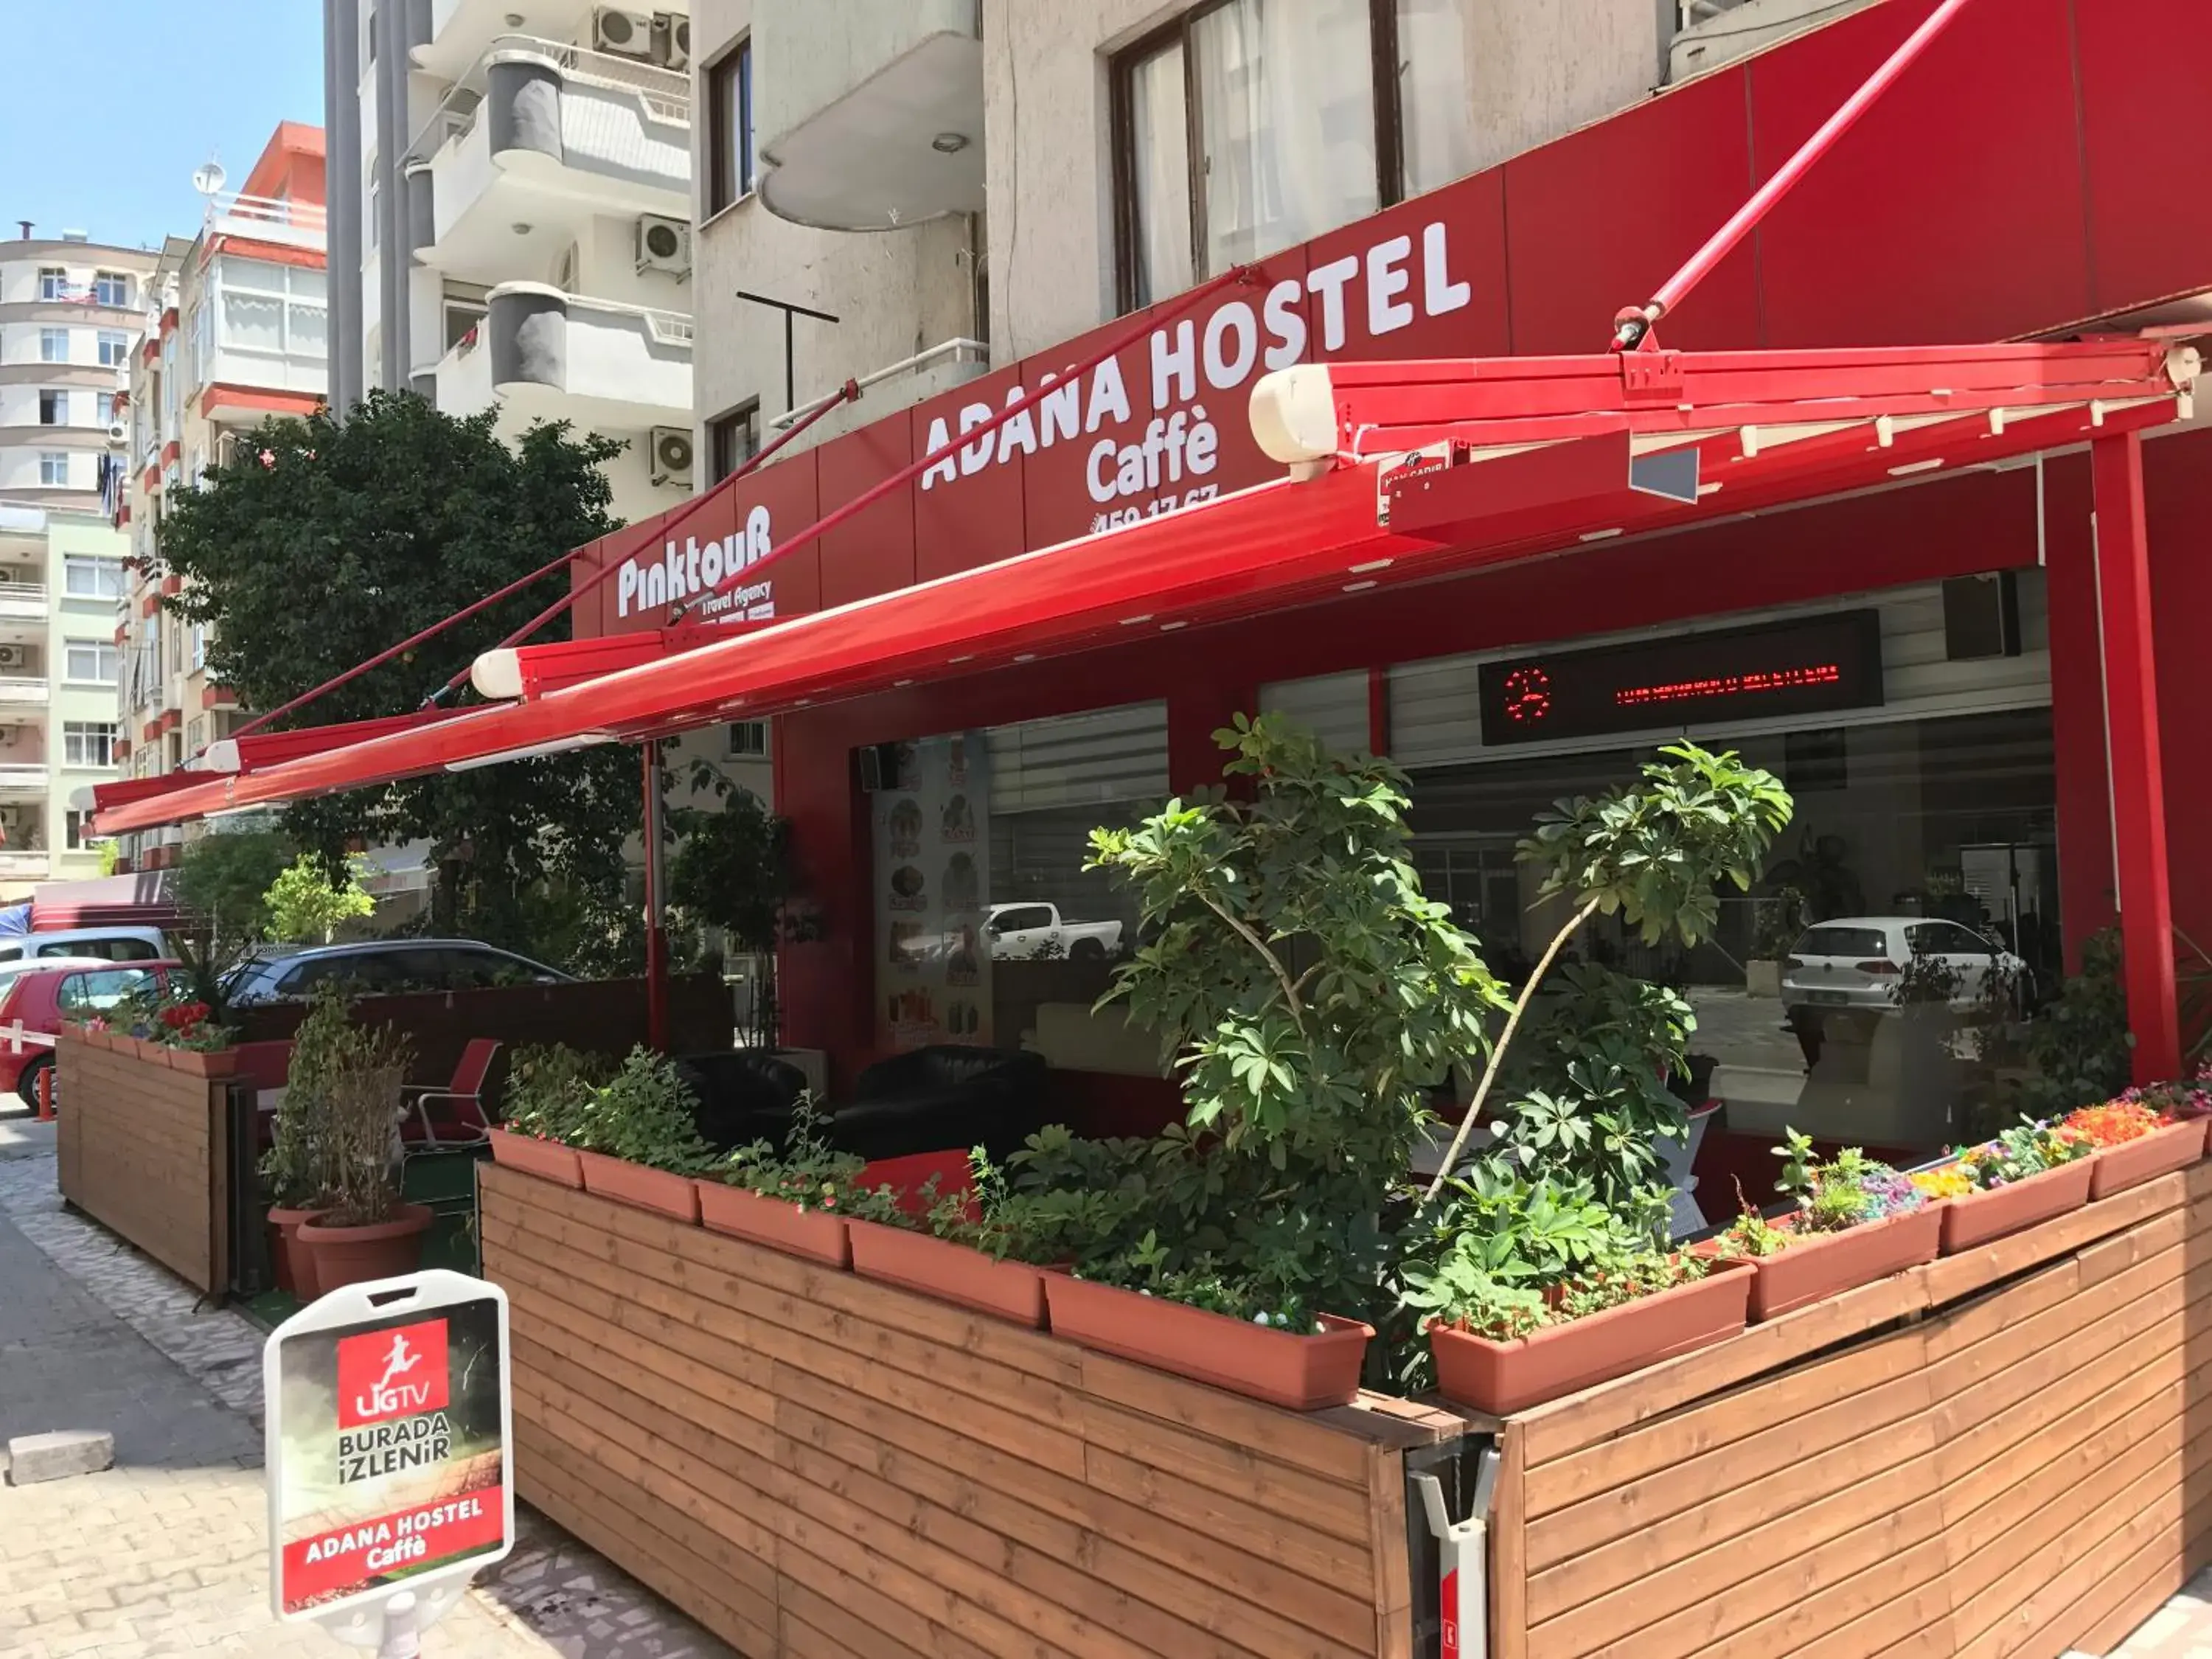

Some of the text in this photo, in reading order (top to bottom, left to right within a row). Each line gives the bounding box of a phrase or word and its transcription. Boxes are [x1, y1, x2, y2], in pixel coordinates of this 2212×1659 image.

[921, 222, 1472, 491] ADANA HOSTEL
[1086, 405, 1218, 502] Caffè
[338, 1412, 451, 1458] BURADA
[305, 1498, 484, 1565] ADANA HOSTEL
[366, 1535, 427, 1571] Caffè
